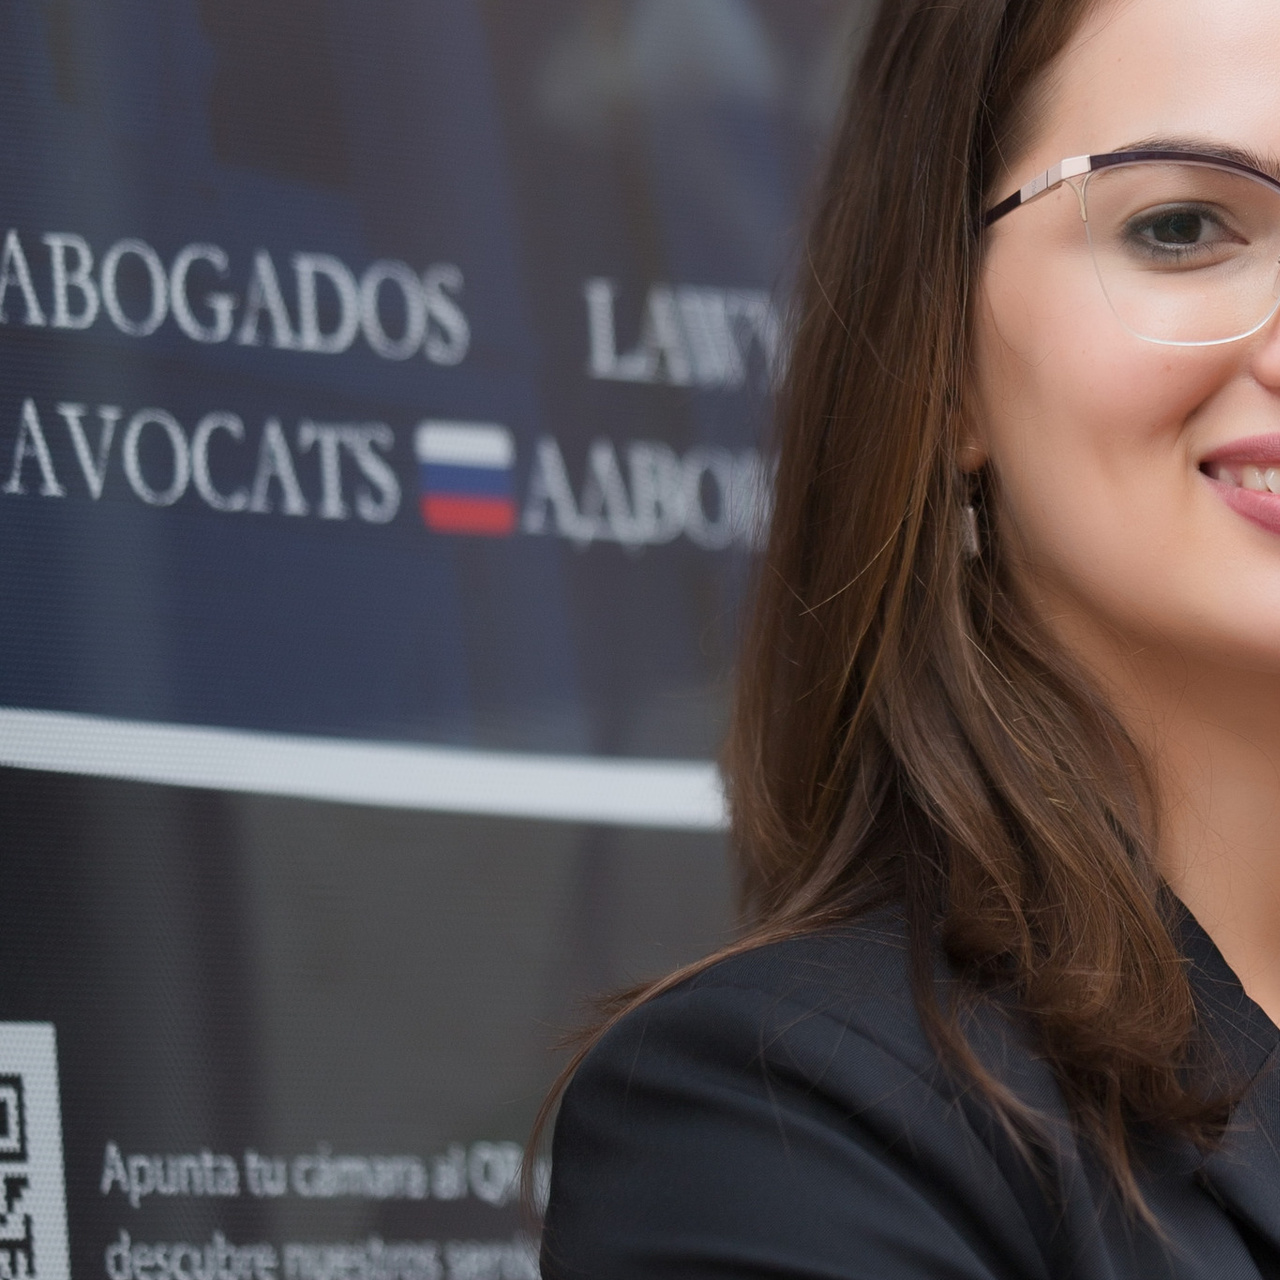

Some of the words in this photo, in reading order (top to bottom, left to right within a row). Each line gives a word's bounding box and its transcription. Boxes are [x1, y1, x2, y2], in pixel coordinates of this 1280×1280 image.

[0, 228, 471, 367] ABOGADOS
[2, 396, 403, 525] AVOCATS
[100, 1139, 241, 1209] Apunta
[245, 1147, 288, 1198] tu
